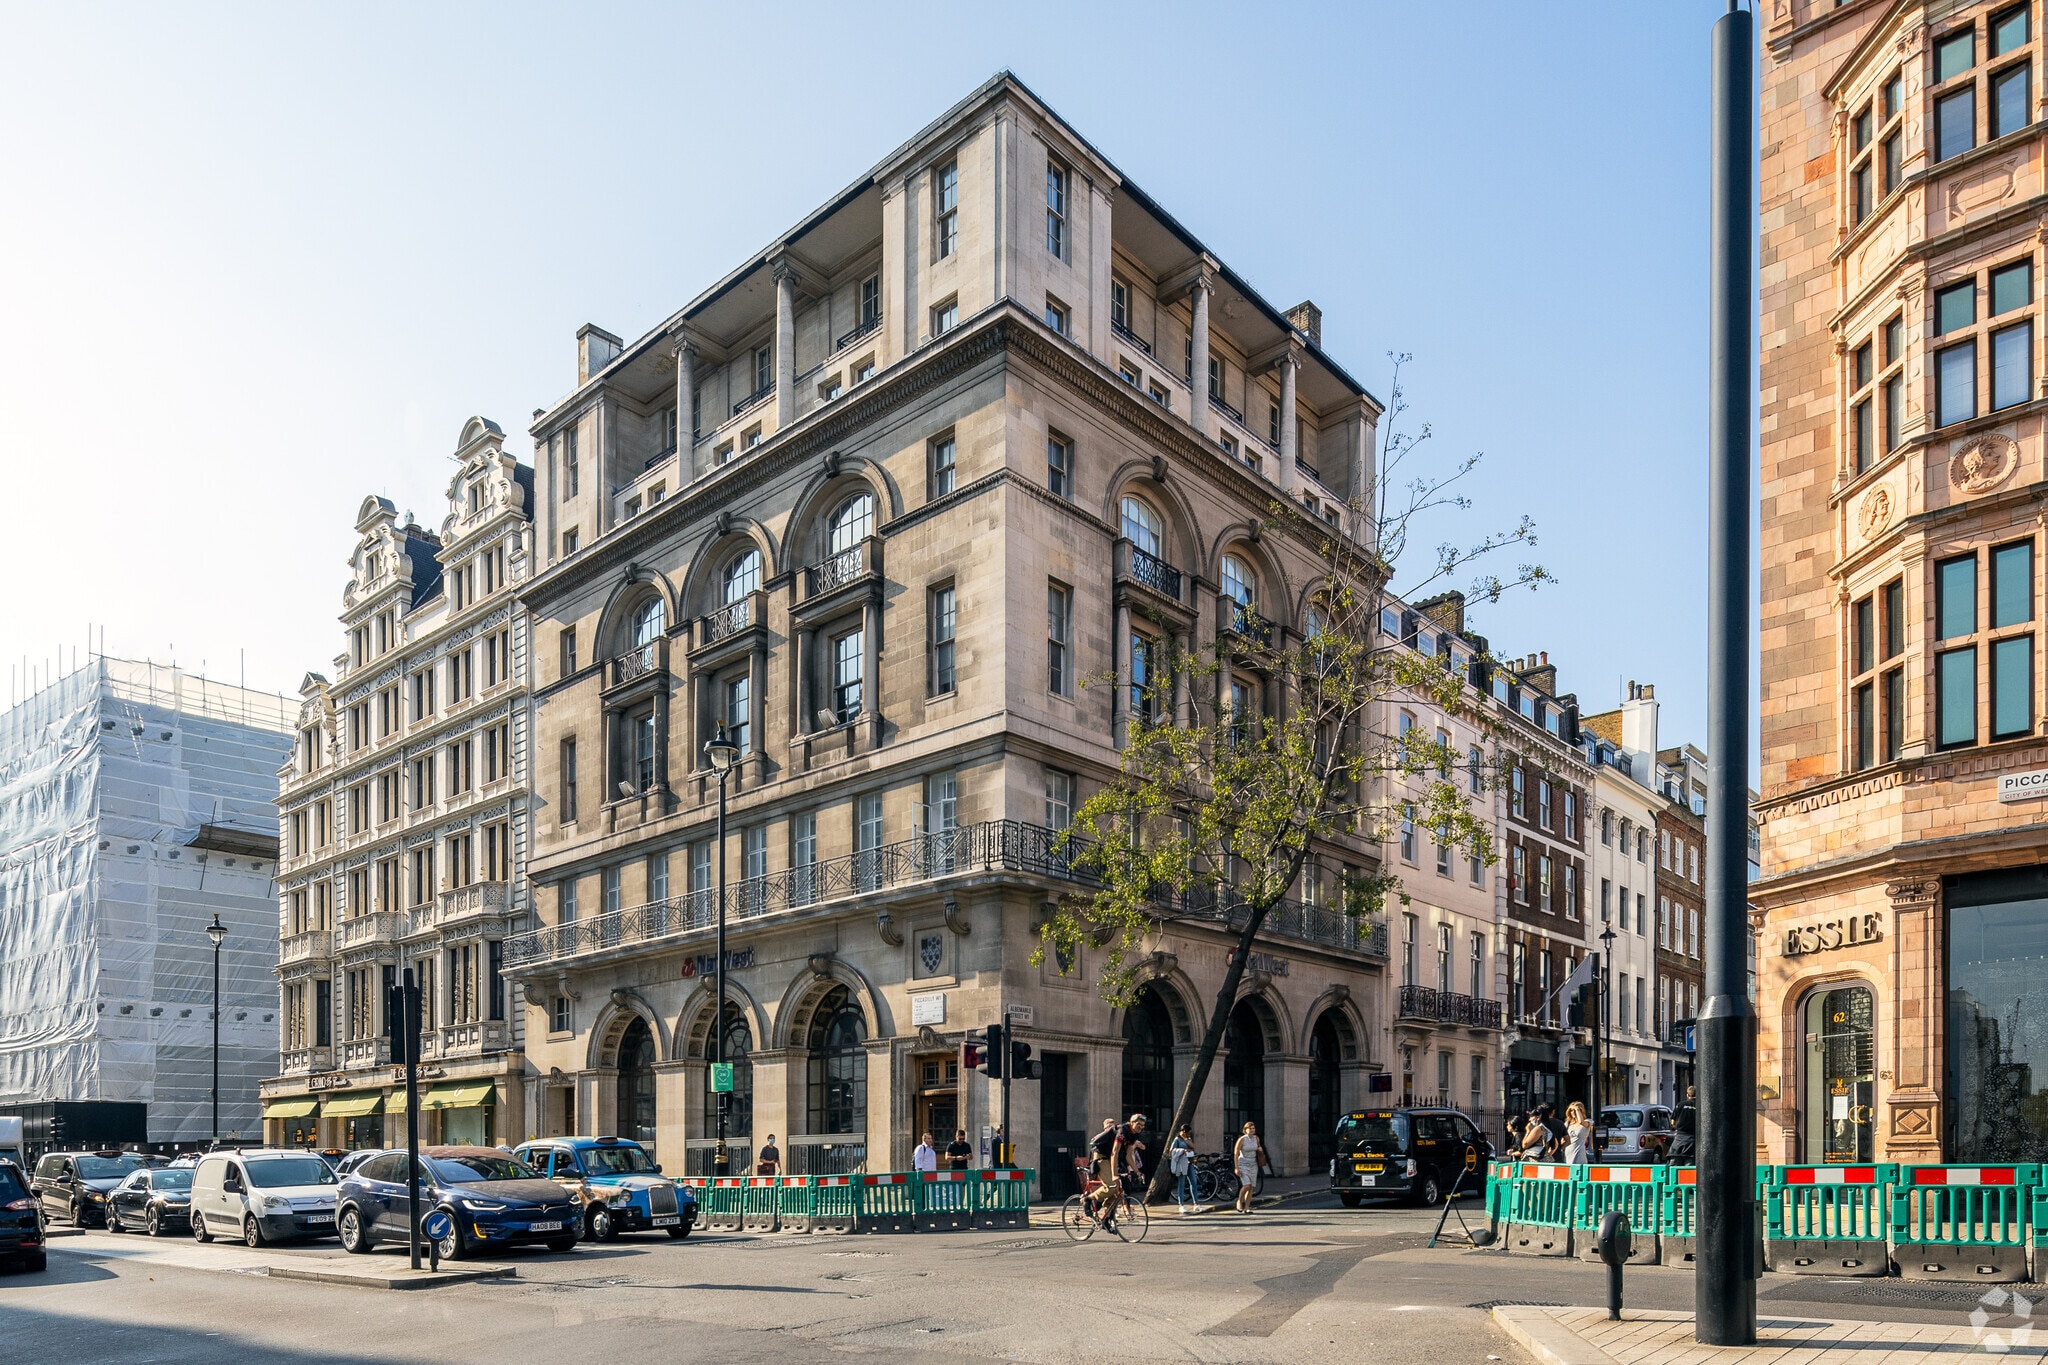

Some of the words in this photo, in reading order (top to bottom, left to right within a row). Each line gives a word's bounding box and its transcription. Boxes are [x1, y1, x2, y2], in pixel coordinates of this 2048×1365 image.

[1781, 912, 1884, 957] ESSIE
[1833, 1012, 1846, 1022] 62
[1880, 1070, 1893, 1080] 62
